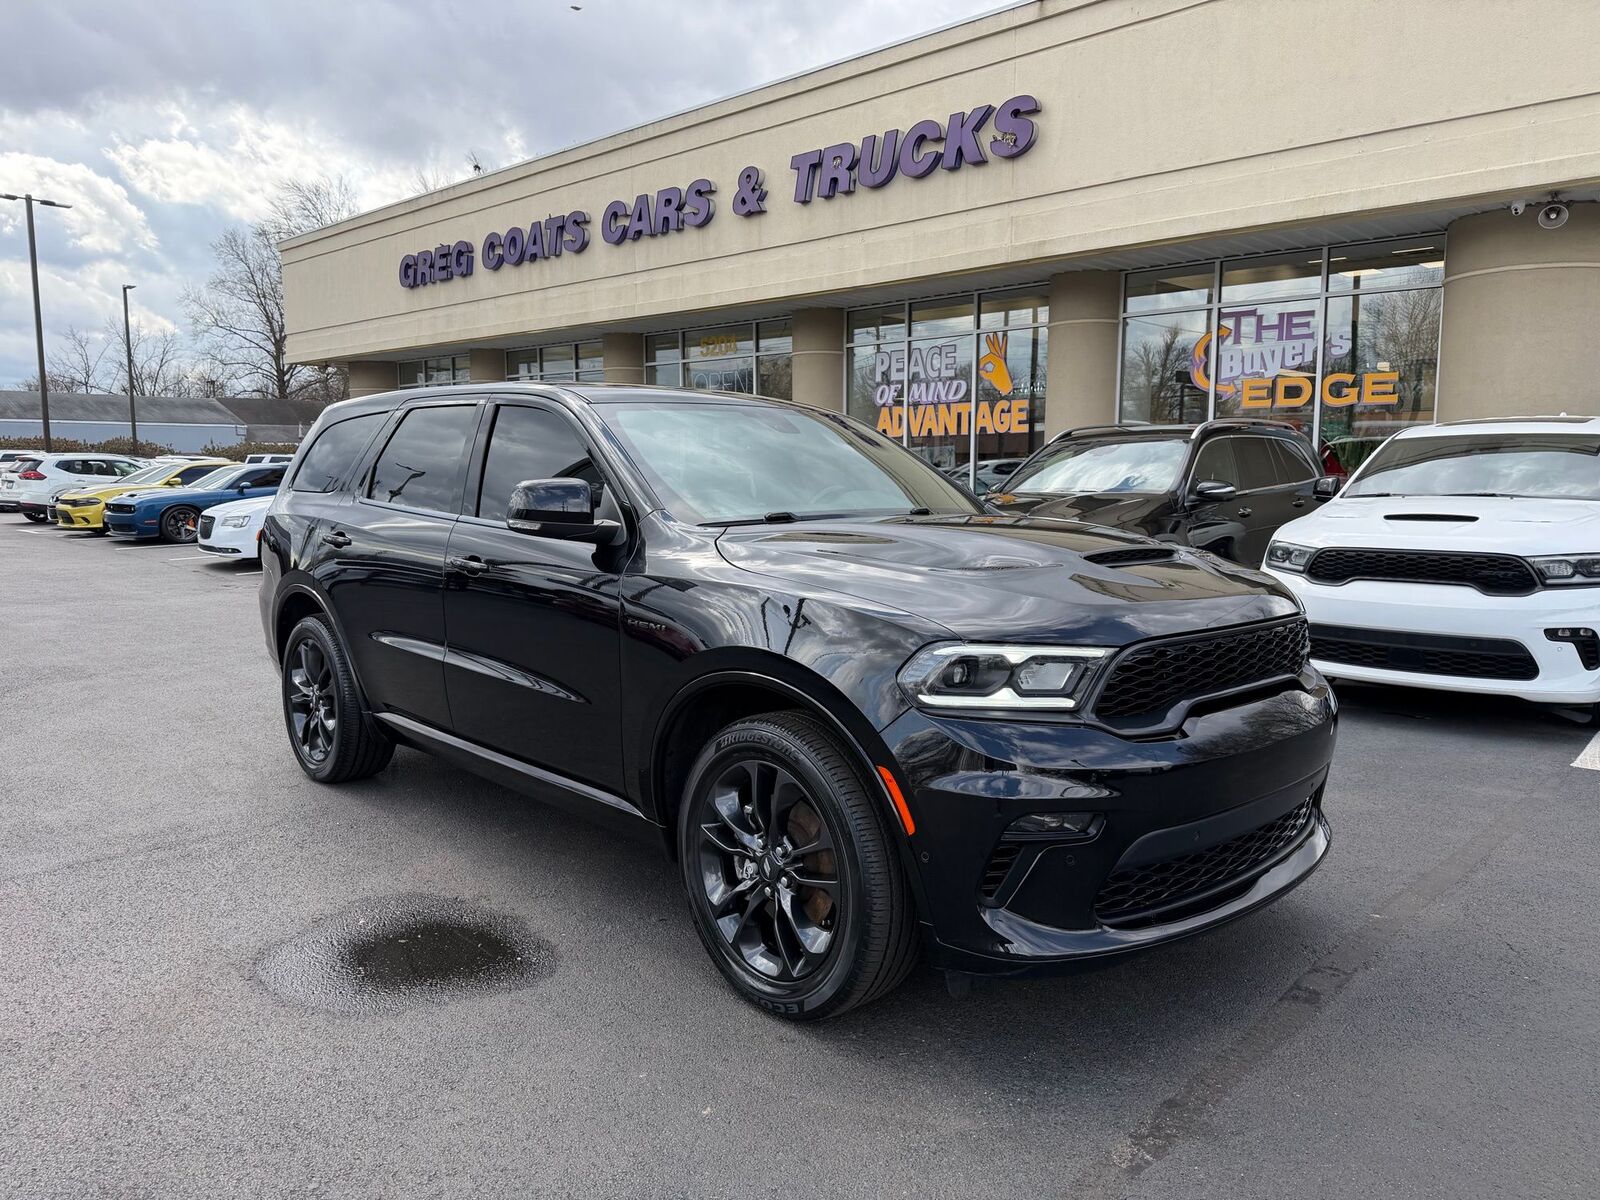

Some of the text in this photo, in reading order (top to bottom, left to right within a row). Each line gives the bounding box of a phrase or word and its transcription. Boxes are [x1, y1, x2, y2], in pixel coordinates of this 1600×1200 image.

[399, 94, 1042, 289] GREG COATS CARS & TRUCKS
[1220, 308, 1316, 345] THE
[875, 344, 957, 383] PEACE
[875, 380, 968, 406] OF MIND
[1240, 371, 1400, 409] EDGE
[876, 399, 1029, 437] ADVANTAGE
